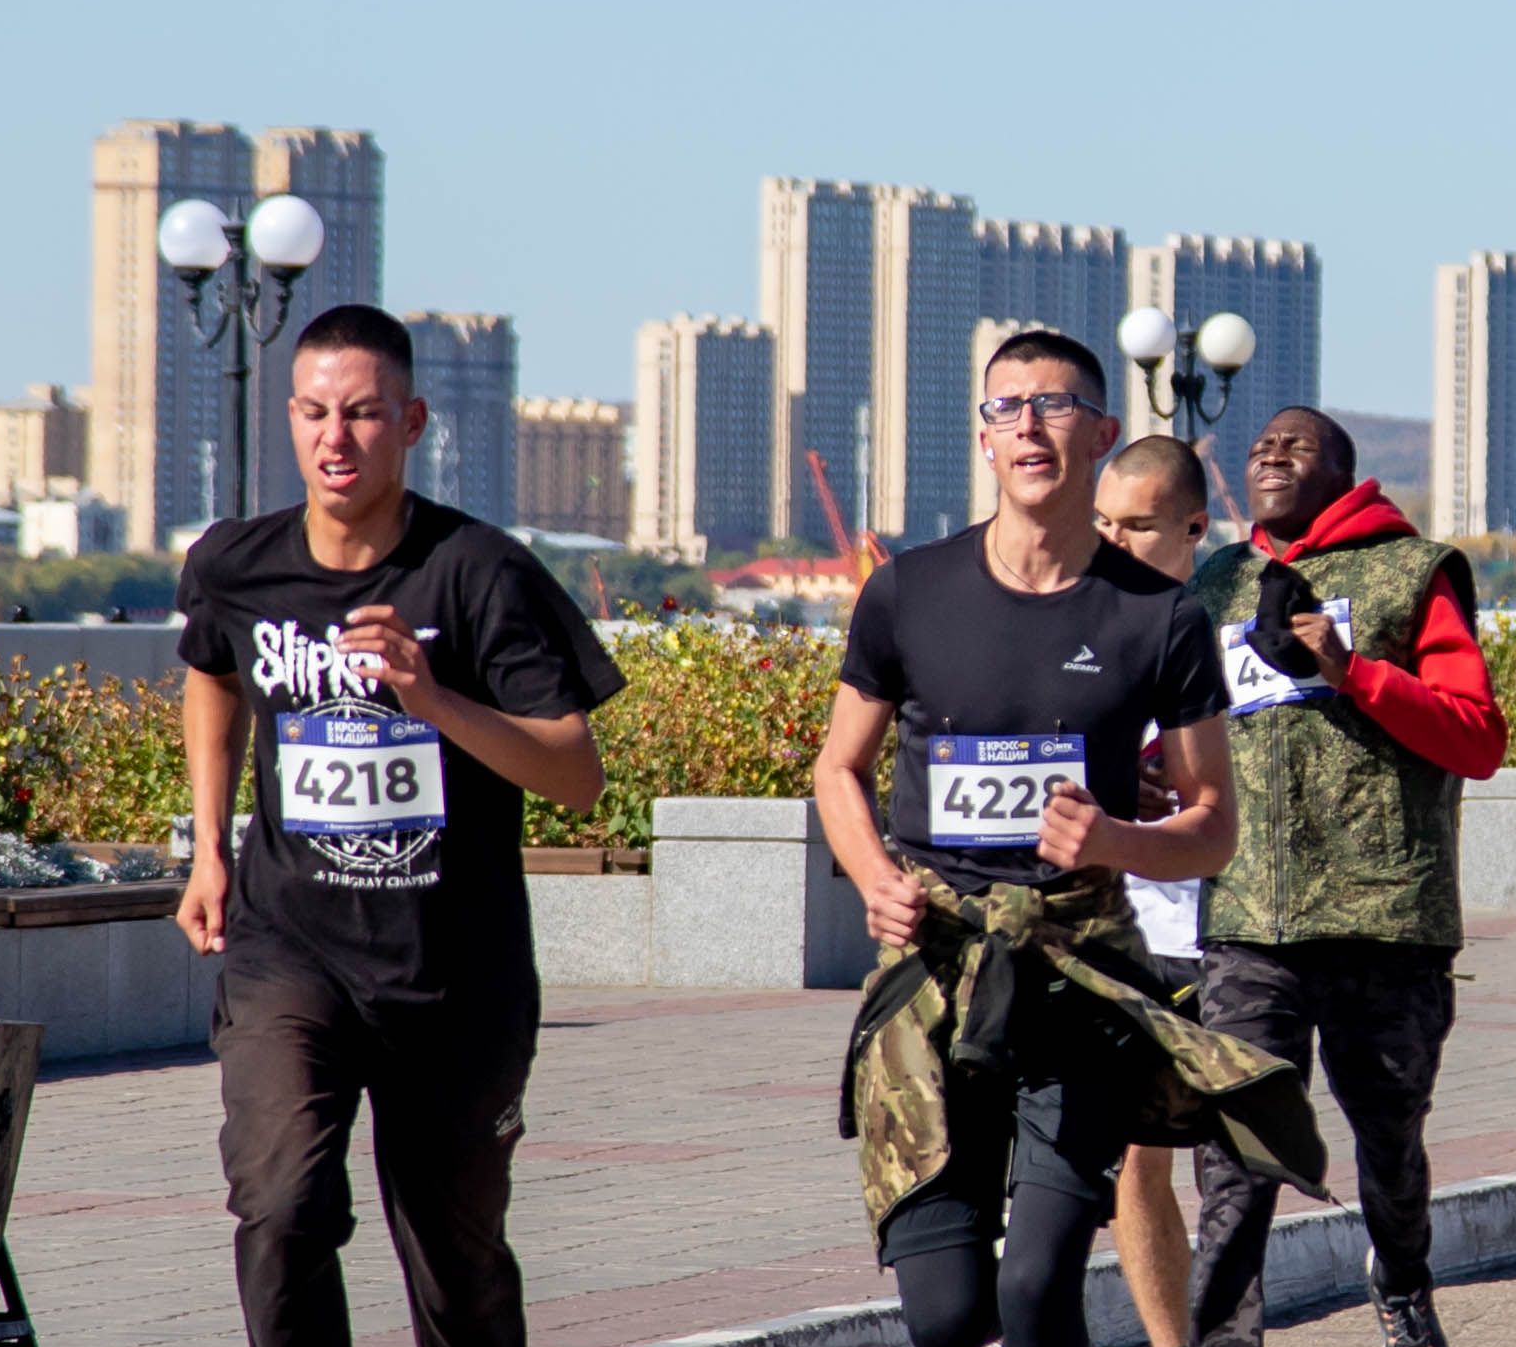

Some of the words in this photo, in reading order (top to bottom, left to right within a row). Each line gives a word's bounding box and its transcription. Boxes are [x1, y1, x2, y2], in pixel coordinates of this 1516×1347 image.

[252, 620, 441, 706] Slipkn
[1062, 662, 1103, 674] DEMIX
[334, 732, 379, 746] НАЦИИ
[986, 740, 1020, 751] КРОСС
[987, 750, 1029, 762] НАЦИИ
[294, 756, 421, 806] 4218
